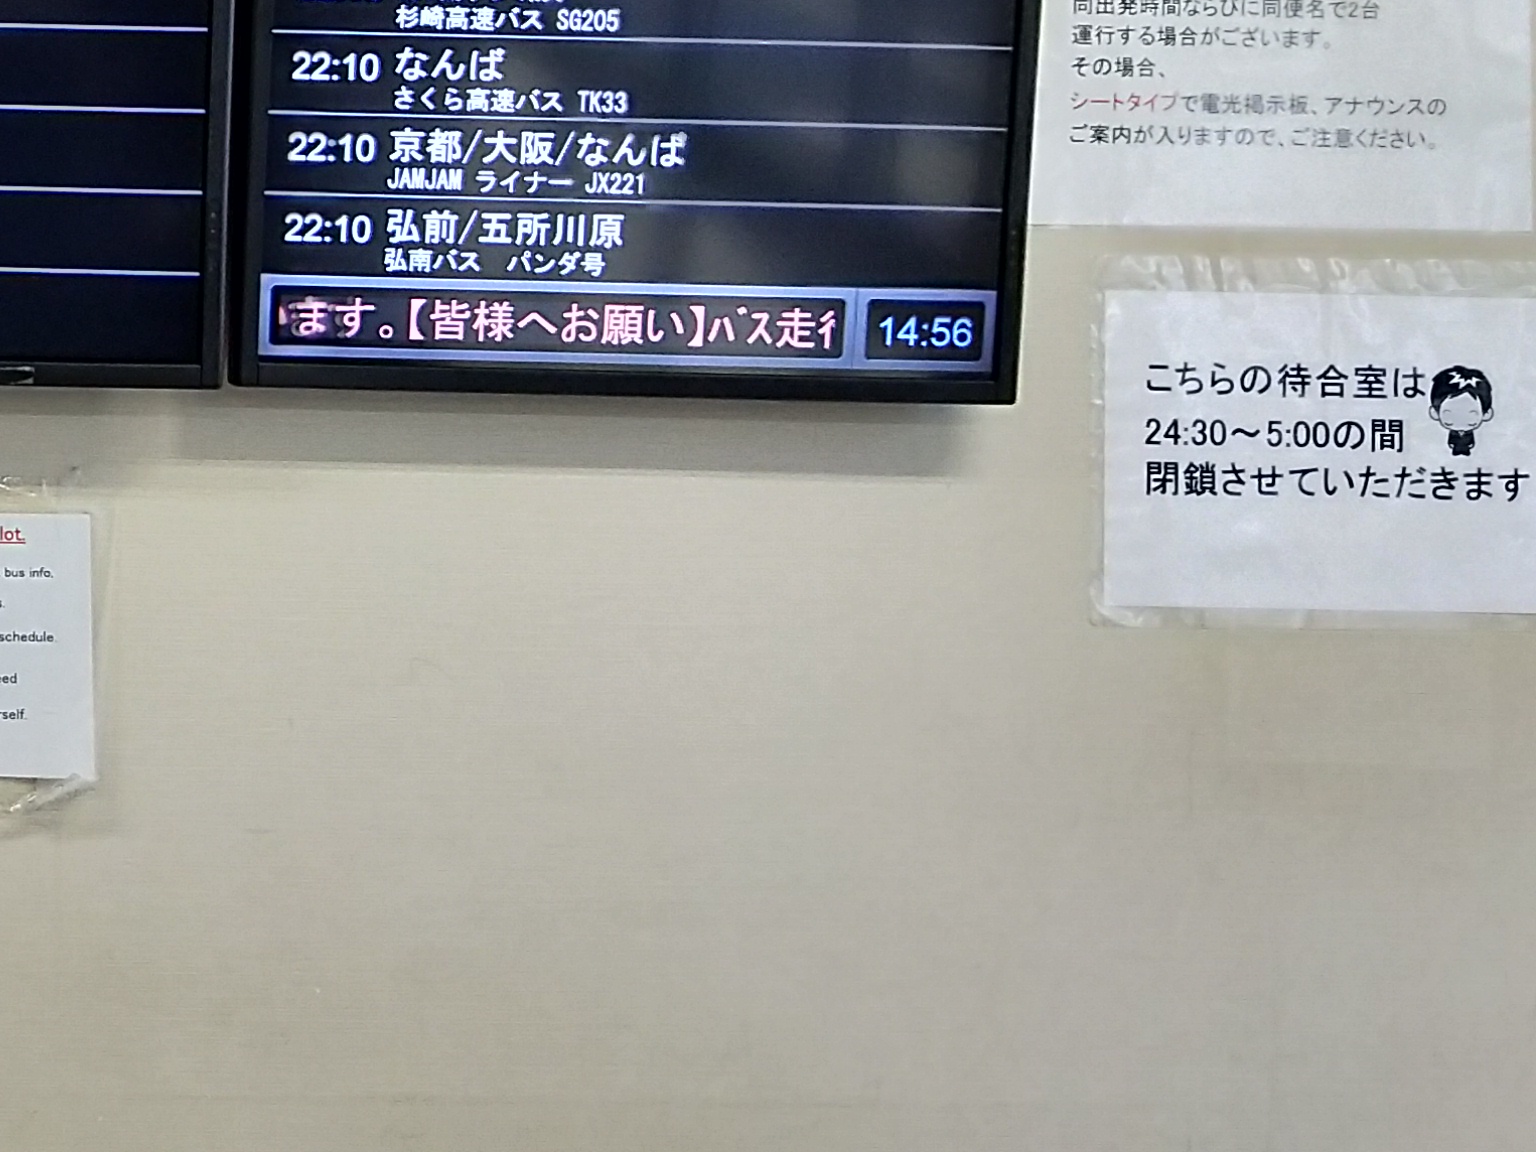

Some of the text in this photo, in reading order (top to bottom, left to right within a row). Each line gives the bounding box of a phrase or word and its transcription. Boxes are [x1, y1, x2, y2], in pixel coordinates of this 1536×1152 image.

[1071, 26, 1331, 50] 運行する場合がございます。
[292, 46, 505, 82] 22:10 なんば
[1071, 58, 1166, 78] その場合、
[393, 86, 628, 113] さくら高速バス TK33
[1070, 92, 1447, 116] シートタイプで電光掲示板、アナウンスの
[1069, 123, 1436, 150] ご案内が入りますので、ご注意ください。
[284, 209, 624, 248] 22:10 弘前/五所川原
[878, 315, 972, 348] 14:56
[1146, 362, 1426, 399] こちらの待合室は
[1145, 461, 1530, 502] 閉鎖させていただきます
[0, 527, 25, 542] lot.
[4, 567, 25, 578] bus
